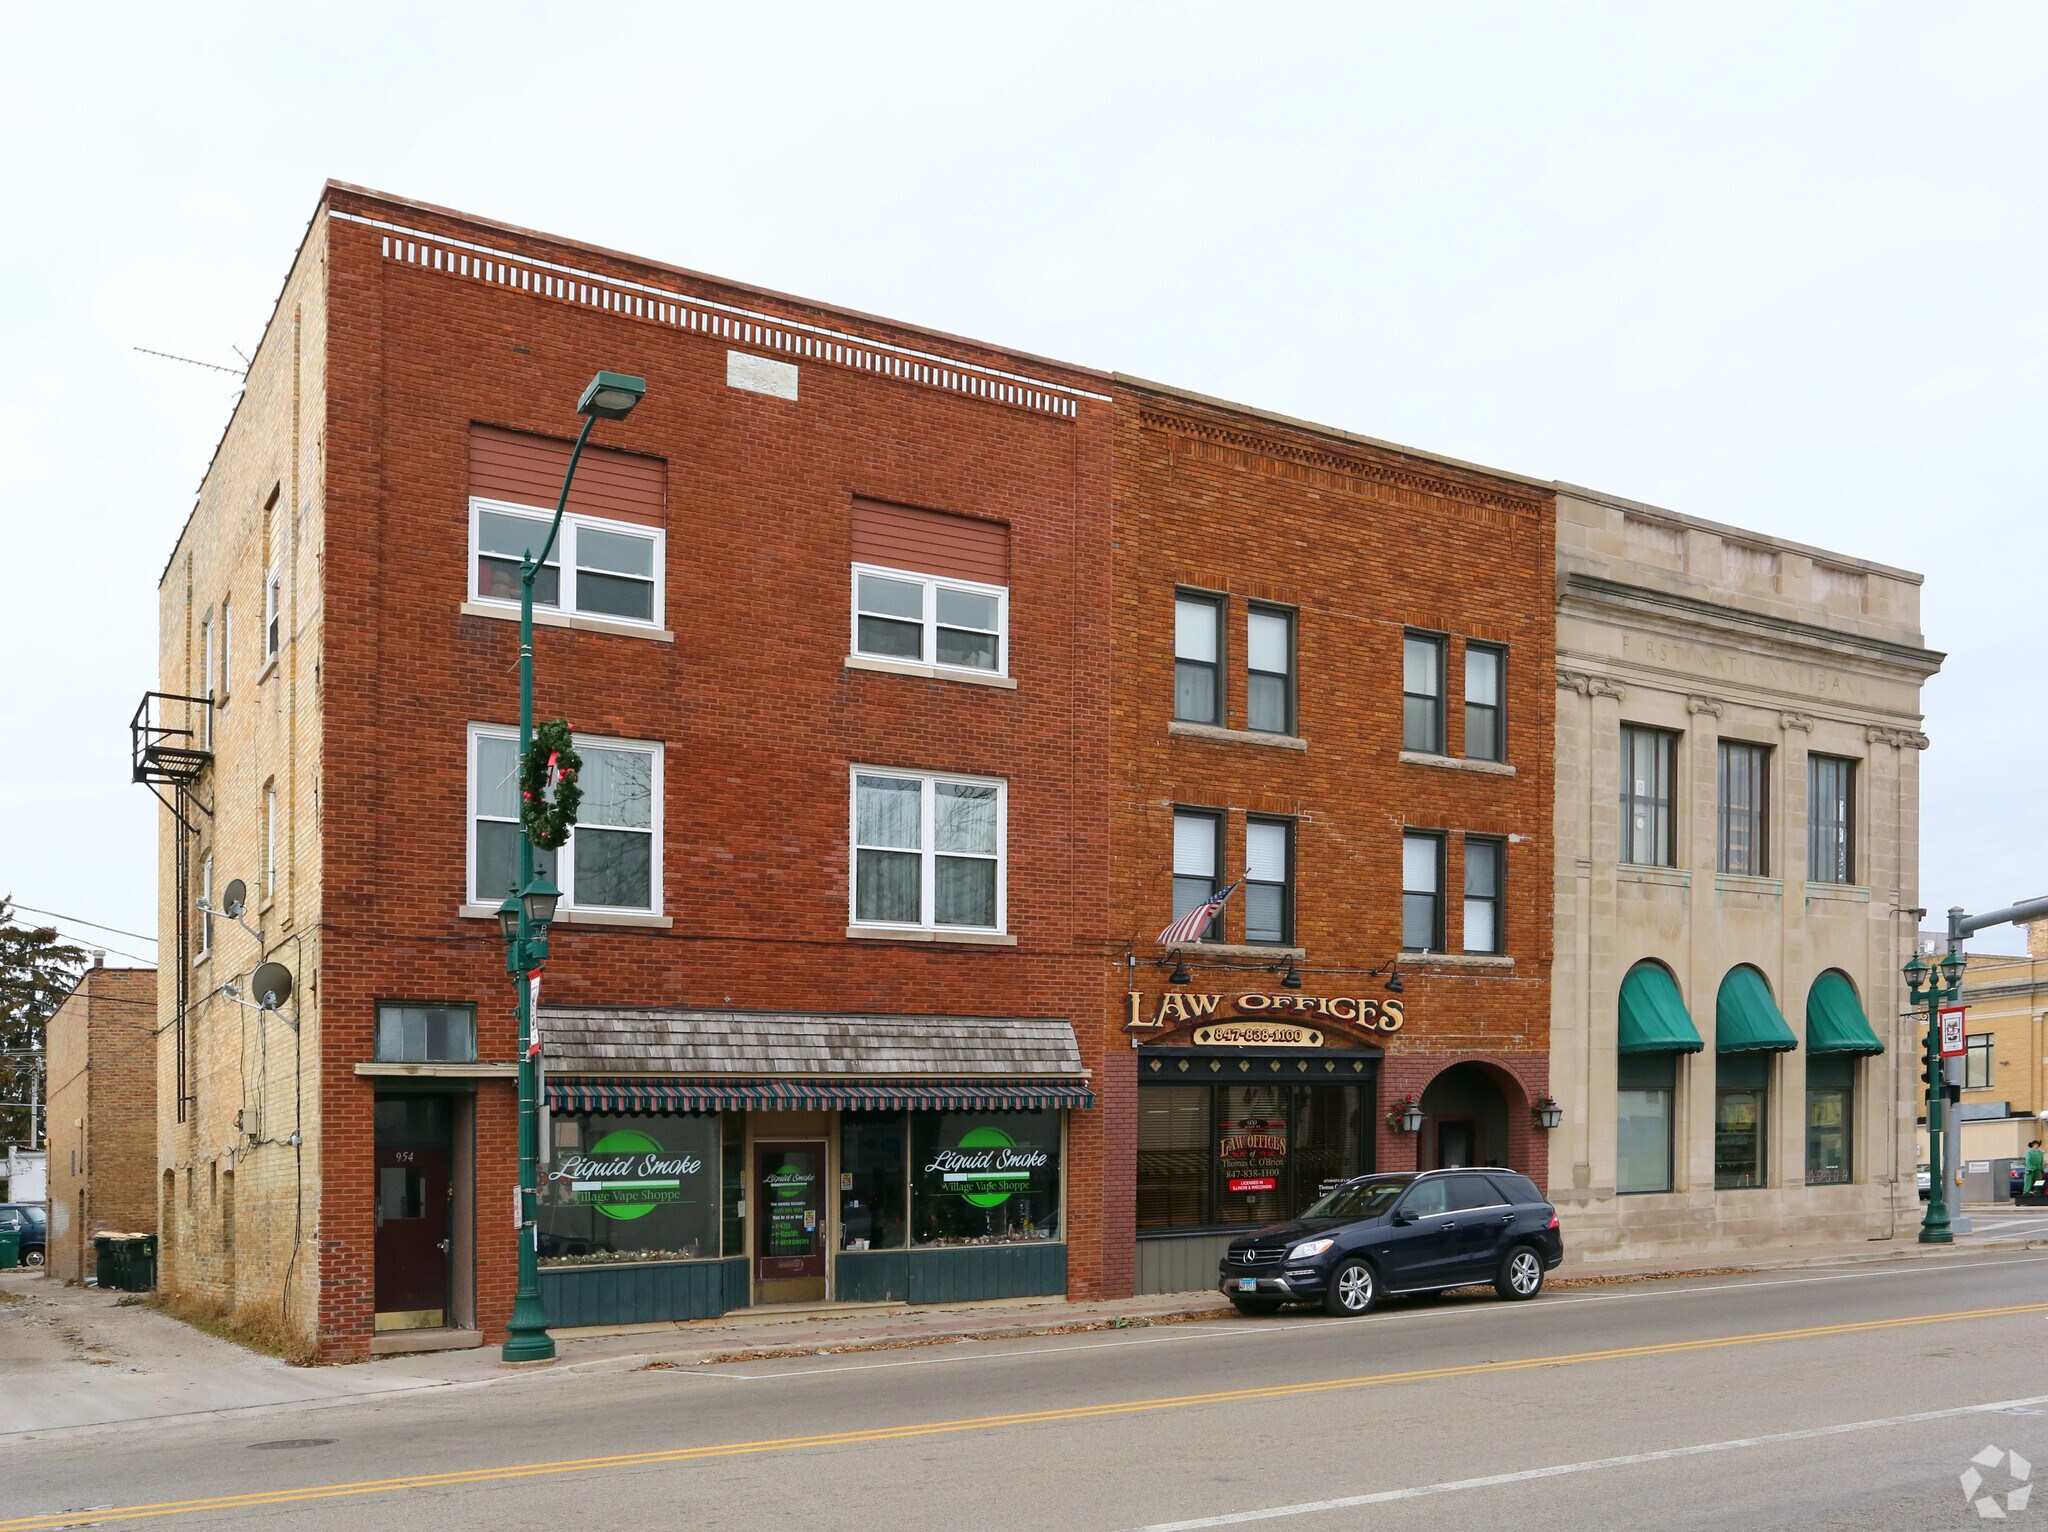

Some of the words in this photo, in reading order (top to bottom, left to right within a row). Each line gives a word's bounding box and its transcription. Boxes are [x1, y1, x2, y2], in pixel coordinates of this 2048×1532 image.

[1622, 634, 1684, 663] FIRST
[1699, 652, 1808, 689] NATIONAL
[1817, 673, 1868, 699] BANK
[1125, 991, 1224, 1031] LAW
[1232, 994, 1404, 1034] OFFICES
[1213, 1028, 1303, 1042] 847-838-1100
[1220, 1135, 1243, 1158] LAW
[1247, 1134, 1287, 1156] OFFICES
[395, 1151, 414, 1163] 954
[924, 1149, 995, 1172] Liquid
[995, 1148, 1048, 1170] Smoke
[1249, 1149, 1257, 1159] of
[548, 1155, 636, 1181] Liquid
[637, 1153, 702, 1178] Smoke
[1222, 1159, 1248, 1168] Thomas
[762, 1173, 792, 1184] Liquid
[792, 1173, 815, 1182] Smoke
[1226, 1168, 1280, 1179] 847-838-1100
[943, 1182, 974, 1193] Village
[976, 1181, 997, 1191] Vape
[998, 1180, 1030, 1191] Shoppe
[612, 1190, 640, 1202] Vape
[640, 1189, 680, 1201] Shoppe
